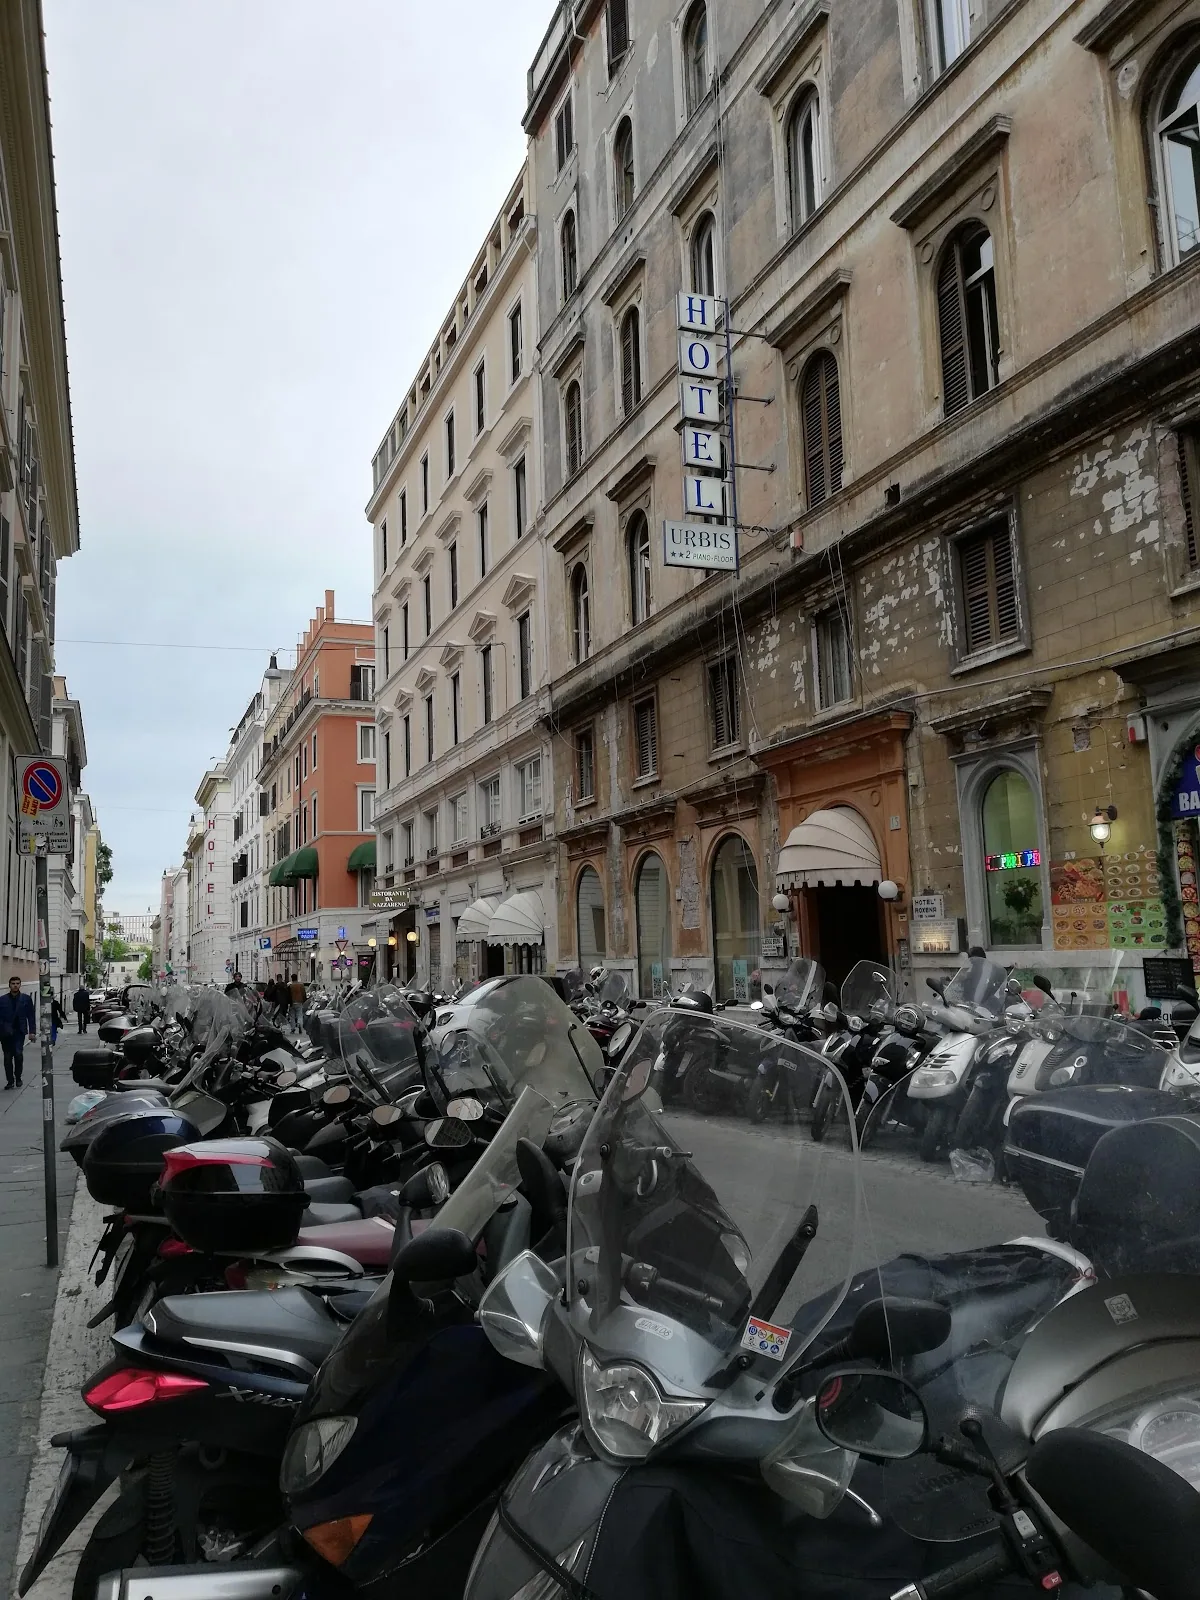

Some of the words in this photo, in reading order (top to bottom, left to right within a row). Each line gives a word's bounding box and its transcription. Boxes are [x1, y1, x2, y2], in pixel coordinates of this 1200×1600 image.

[685, 296, 715, 509] HOTEL
[671, 528, 731, 550] URBIS
[685, 550, 691, 559] 2
[207, 819, 215, 915] HOTEL
[1000, 854, 1022, 868] PERI
[260, 938, 269, 949] P
